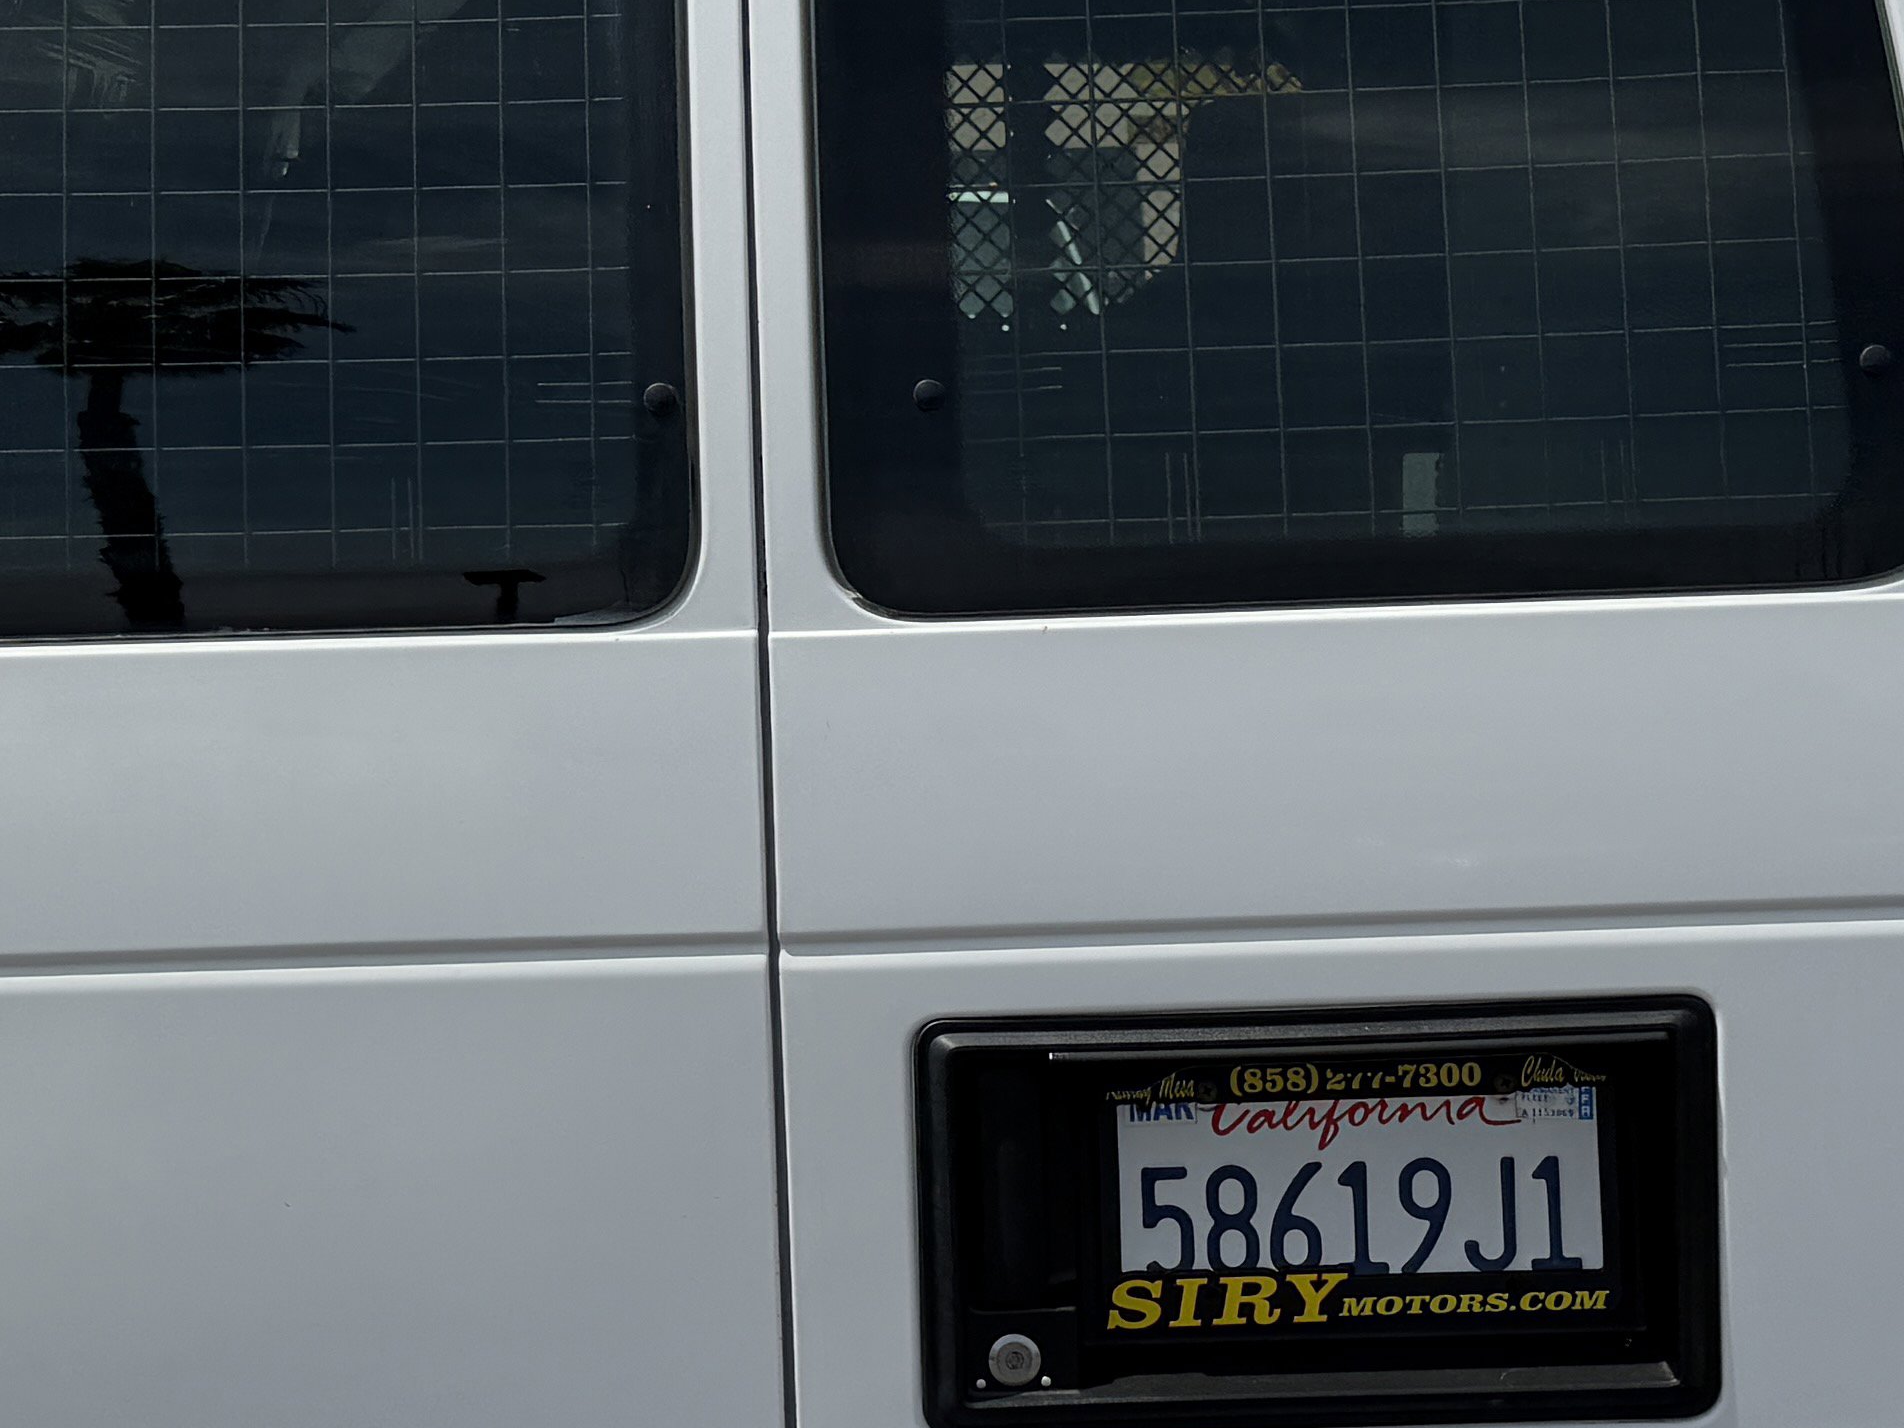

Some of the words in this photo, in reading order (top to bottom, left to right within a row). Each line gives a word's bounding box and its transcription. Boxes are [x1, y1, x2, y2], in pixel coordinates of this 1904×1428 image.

[1229, 1063, 1319, 1097] (858)
[1521, 1055, 1565, 1088] Chula
[1210, 1093, 1521, 1152] California
[1140, 1155, 1583, 1275] 58619J1
[1107, 1271, 1349, 1332] SIRY
